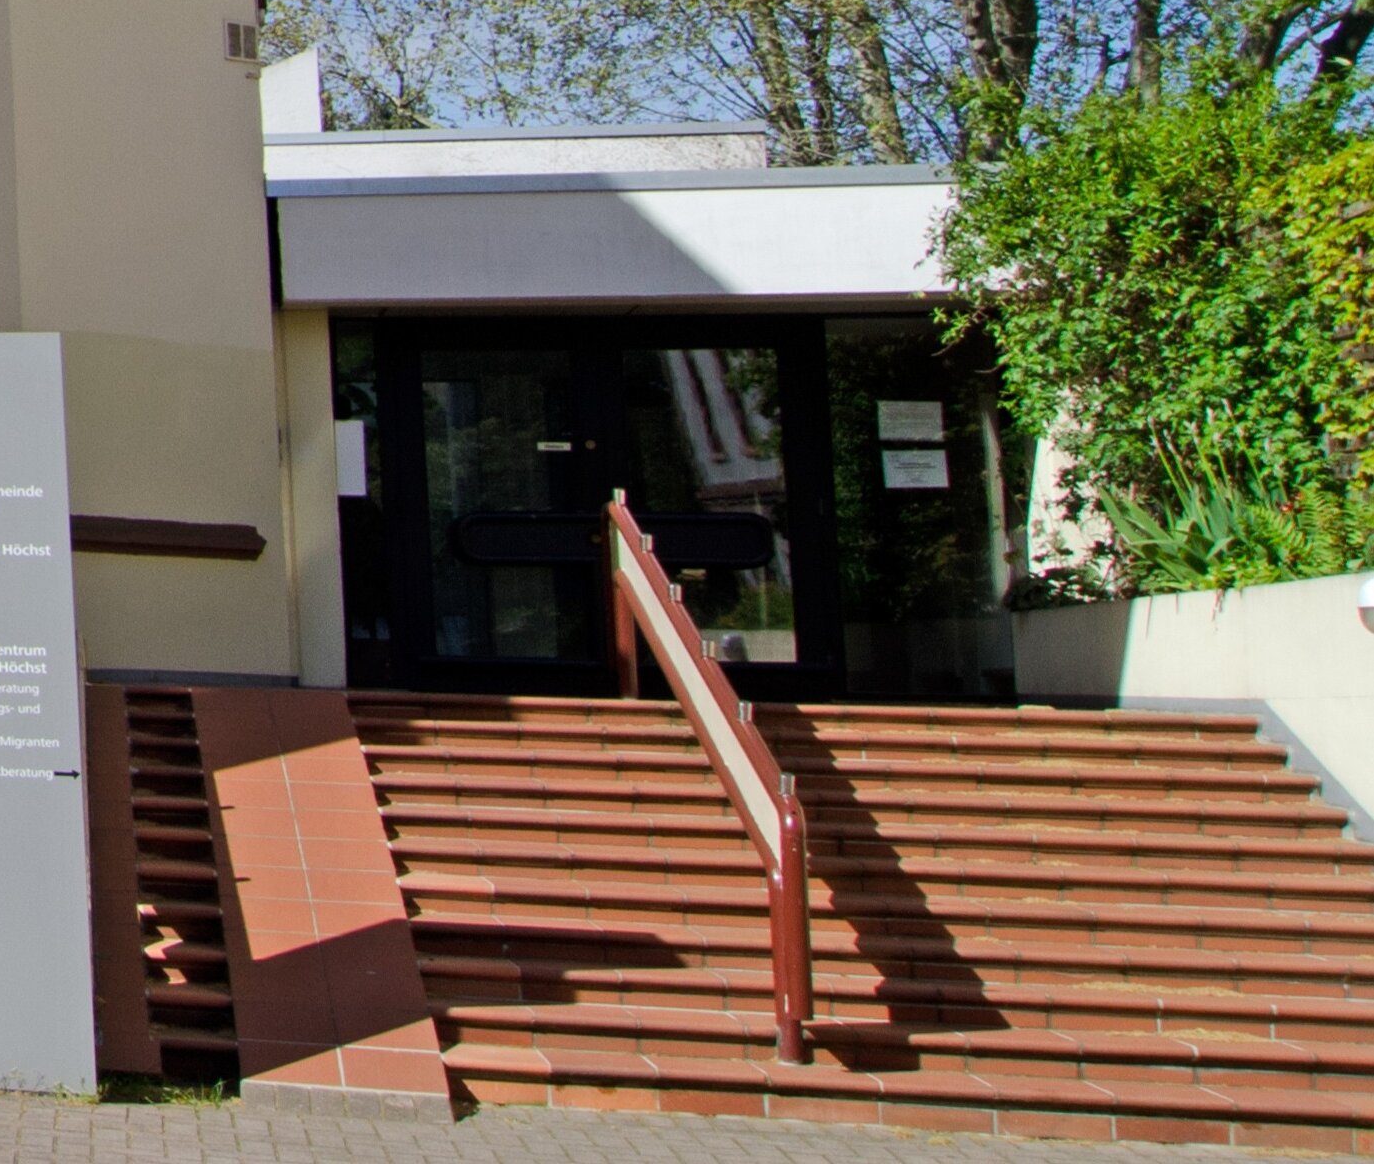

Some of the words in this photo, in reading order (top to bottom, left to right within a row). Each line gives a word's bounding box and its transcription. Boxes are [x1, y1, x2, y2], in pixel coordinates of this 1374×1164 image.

[1, 543, 52, 557] Höchst
[17, 703, 41, 715] und
[0, 735, 60, 750] Migranten
